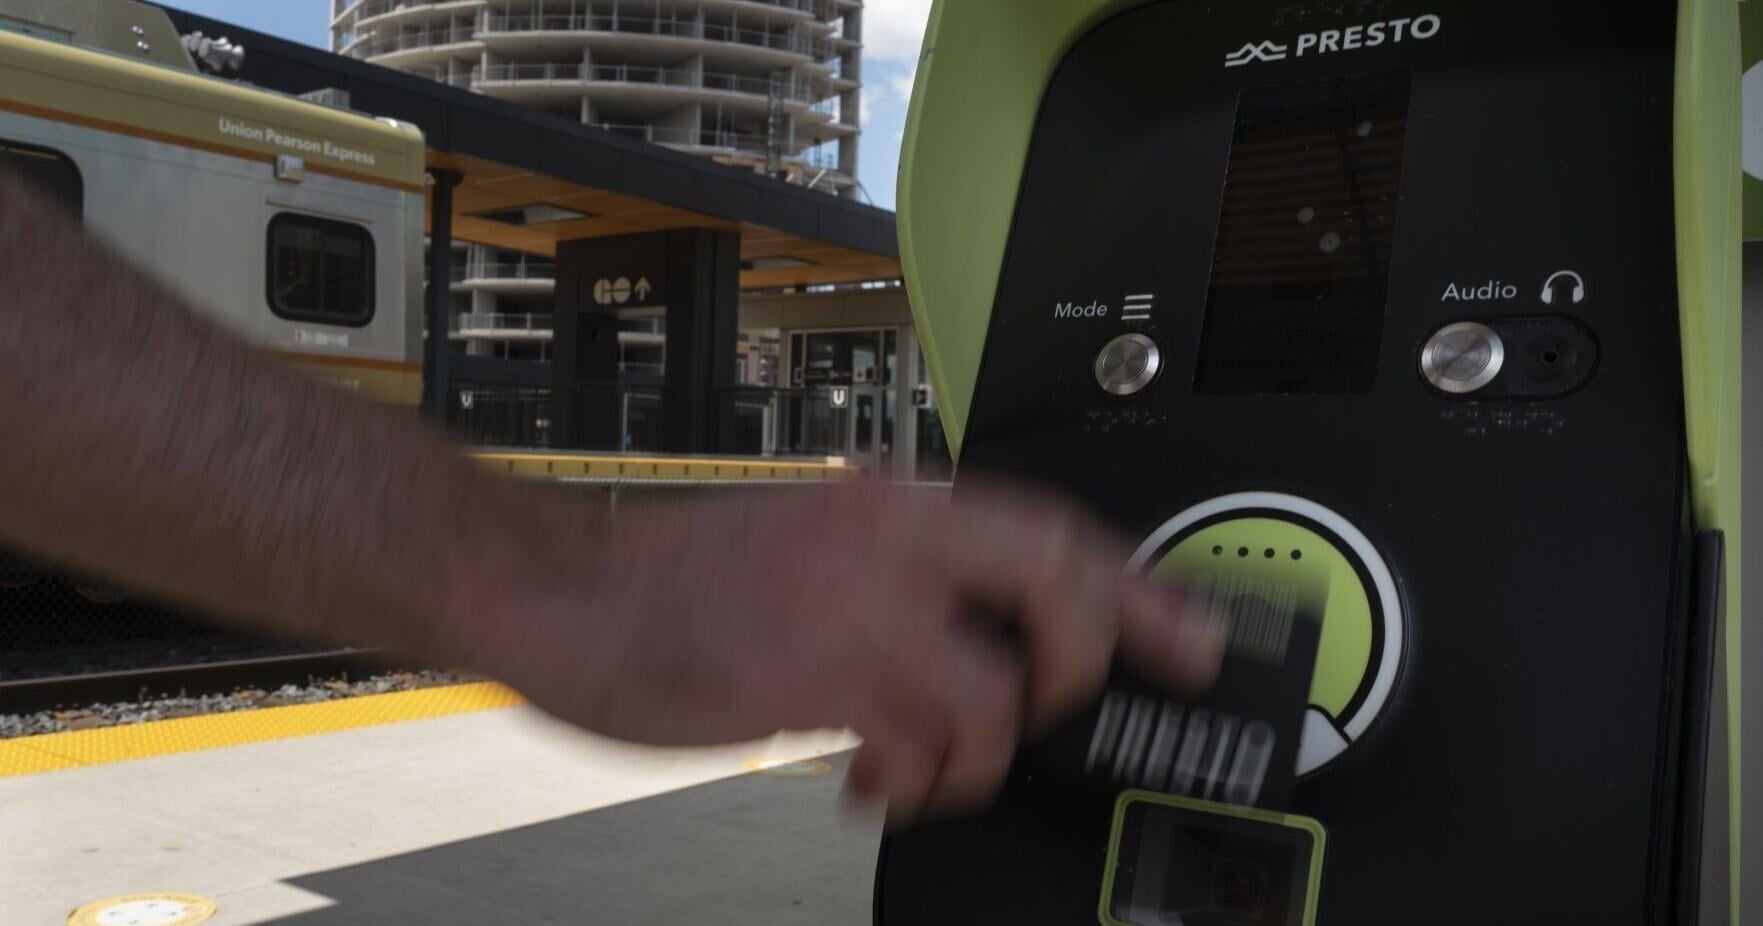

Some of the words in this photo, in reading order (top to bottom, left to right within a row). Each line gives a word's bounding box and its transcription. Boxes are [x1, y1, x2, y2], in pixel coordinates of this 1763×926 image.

[1295, 13, 1441, 58] PRESTO
[218, 117, 263, 141] Union
[265, 128, 321, 153] Pearson
[323, 141, 375, 165] Express
[593, 277, 631, 304] GO
[1440, 279, 1518, 302] Audio
[1054, 299, 1108, 319] Mode
